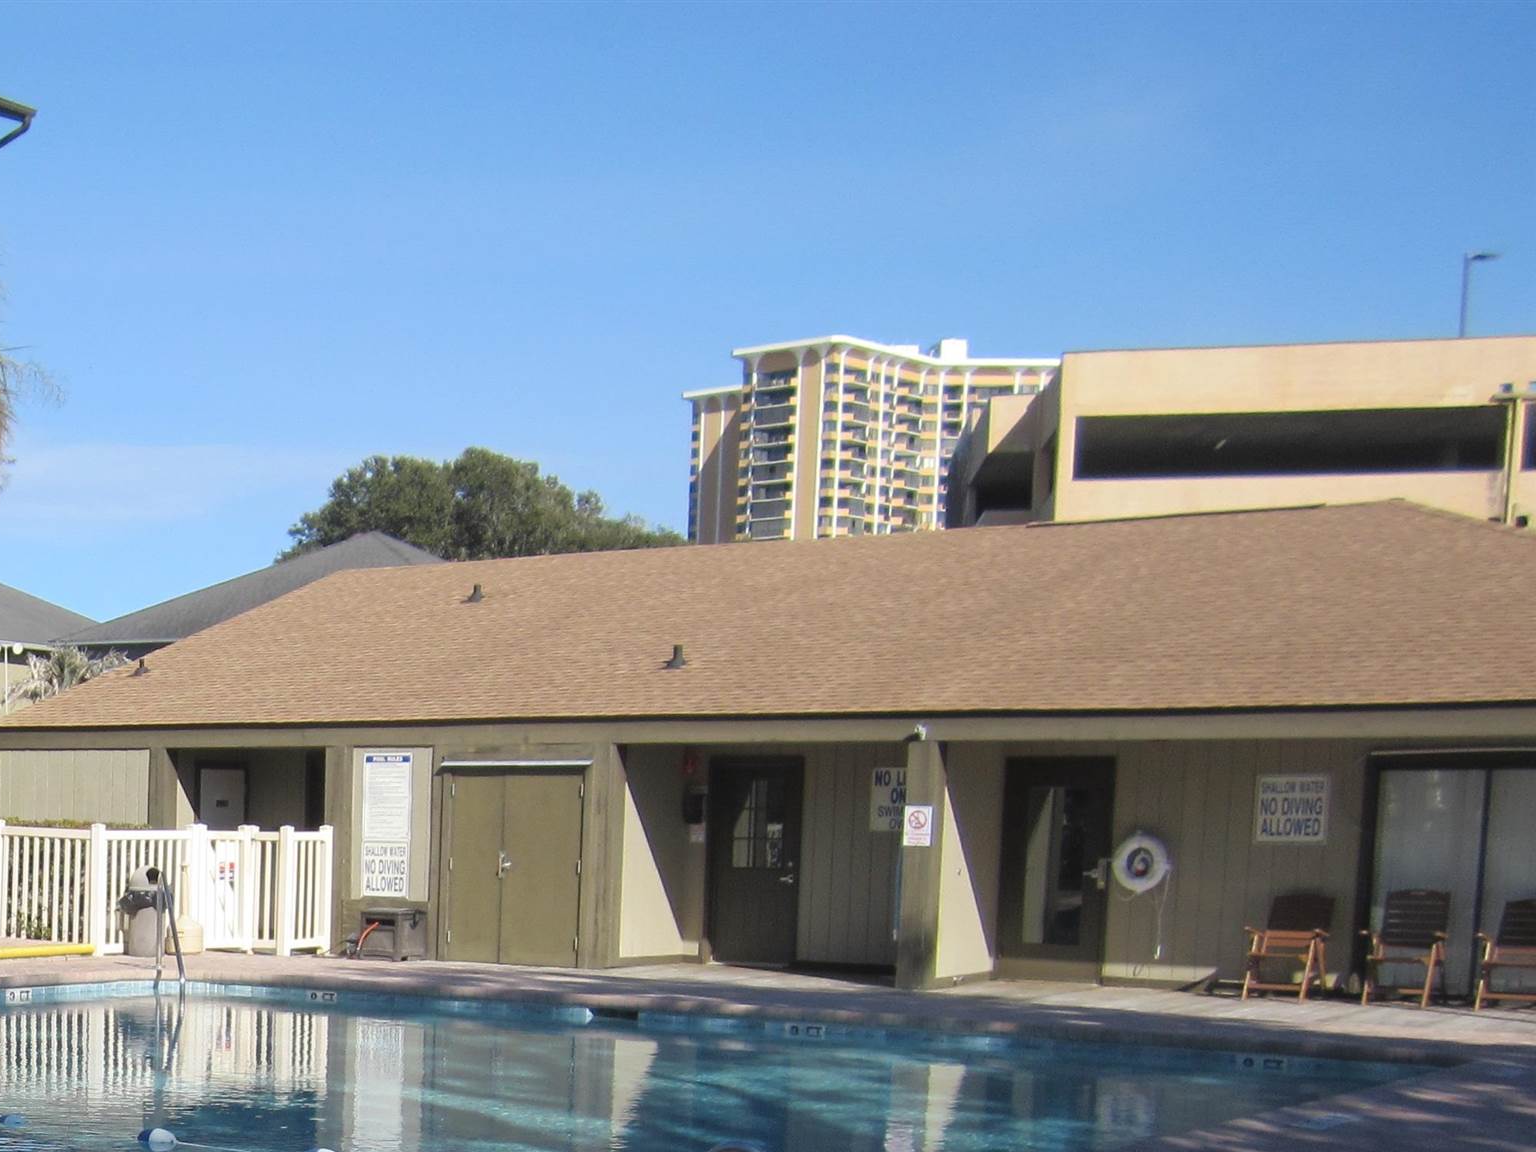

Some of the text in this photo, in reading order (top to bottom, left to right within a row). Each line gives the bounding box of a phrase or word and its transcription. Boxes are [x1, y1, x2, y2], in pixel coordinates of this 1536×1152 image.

[1260, 797, 1324, 816] NO DIVING
[1260, 818, 1321, 836] ALLOWED
[365, 860, 406, 876] NO DIVING
[365, 876, 405, 893] ALLOWED
